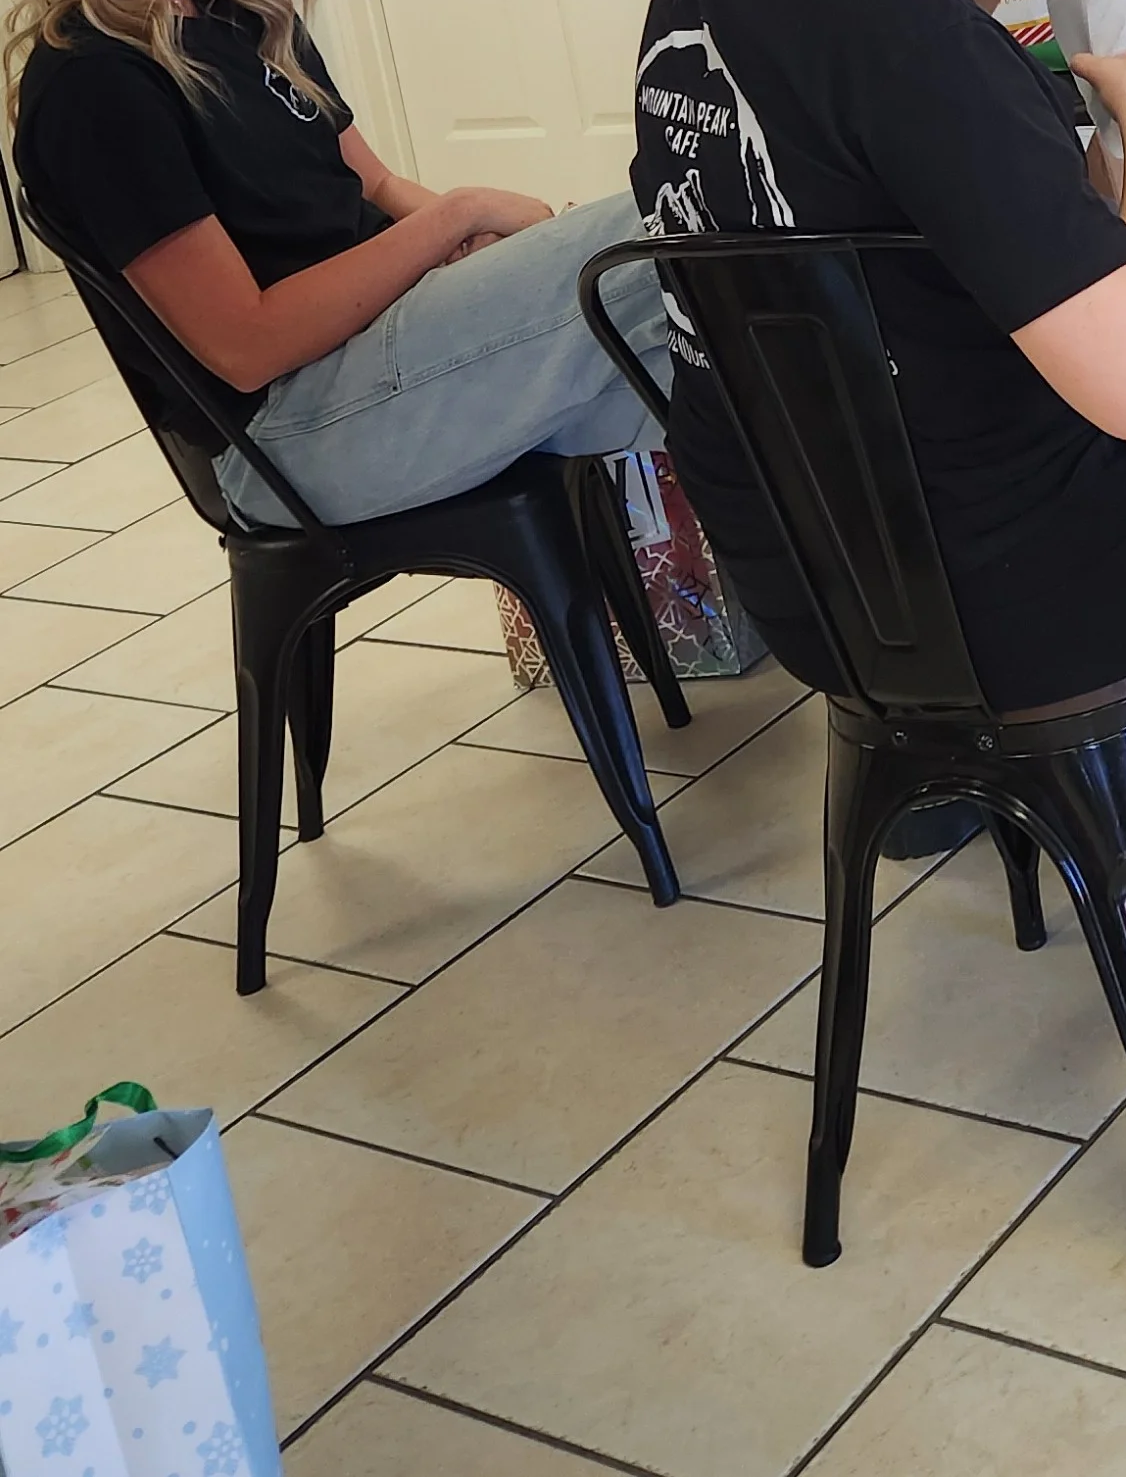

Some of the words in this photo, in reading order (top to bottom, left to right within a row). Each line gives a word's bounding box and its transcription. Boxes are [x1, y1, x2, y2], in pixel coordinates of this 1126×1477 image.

[641, 85, 696, 126] MOUNTAN
[696, 101, 731, 138] PEAK
[664, 125, 701, 159] CAFE
